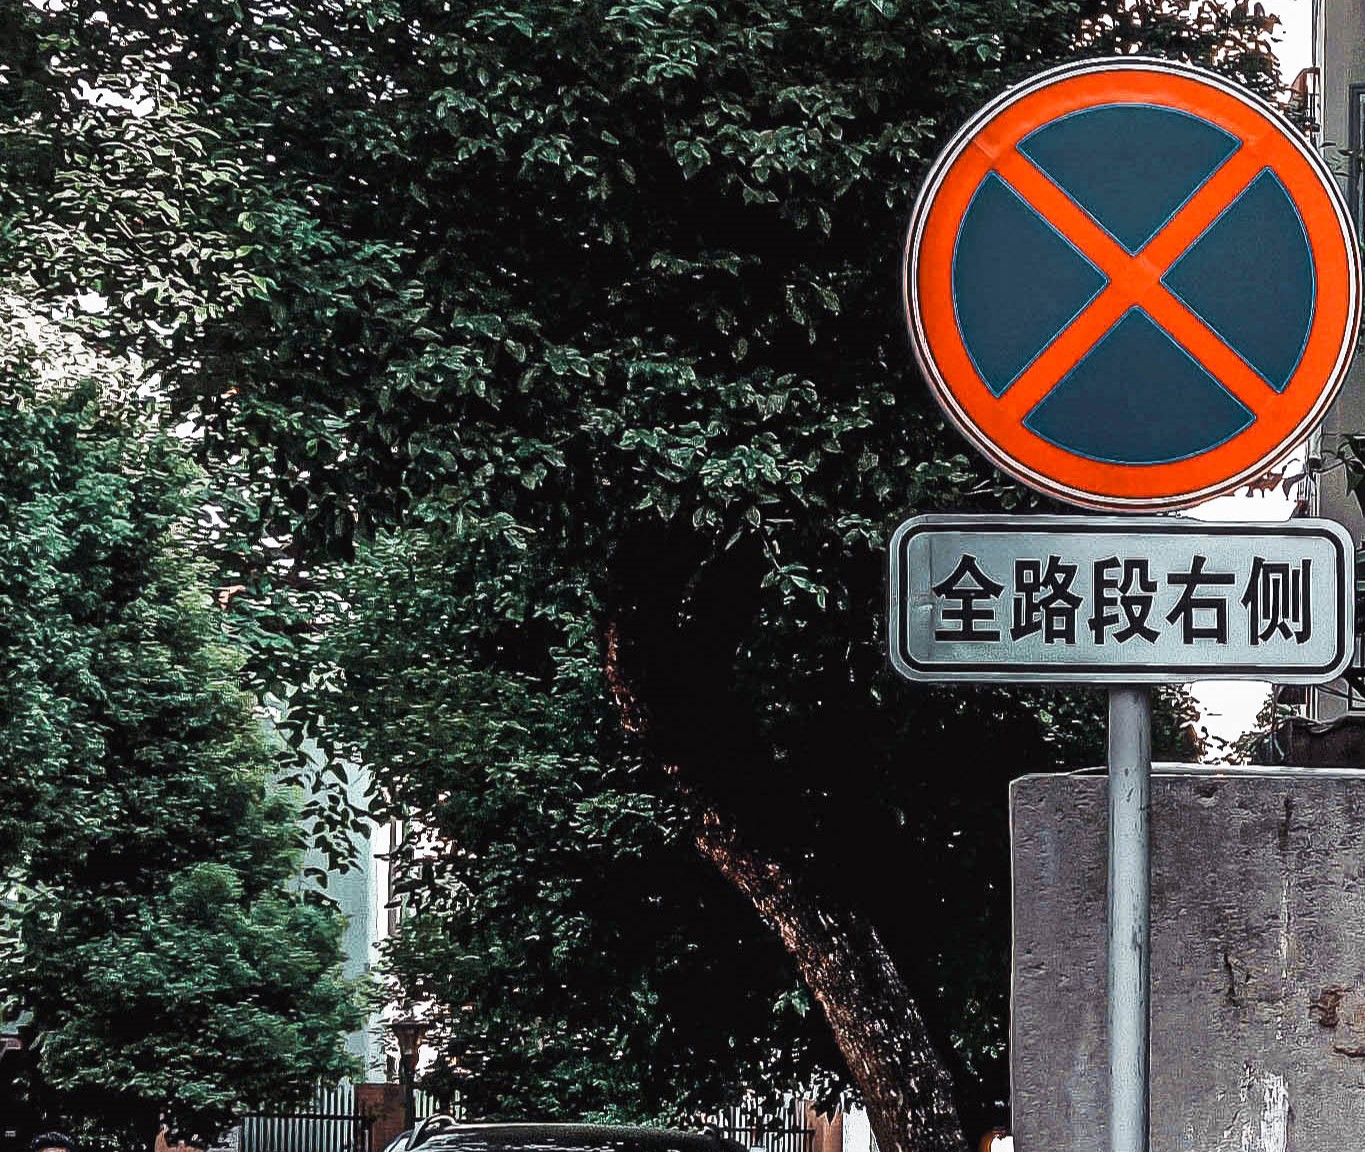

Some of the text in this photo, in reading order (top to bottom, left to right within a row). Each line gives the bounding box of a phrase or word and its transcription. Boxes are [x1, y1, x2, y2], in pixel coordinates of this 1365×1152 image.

[931, 553, 1314, 646] 全路段右侧
